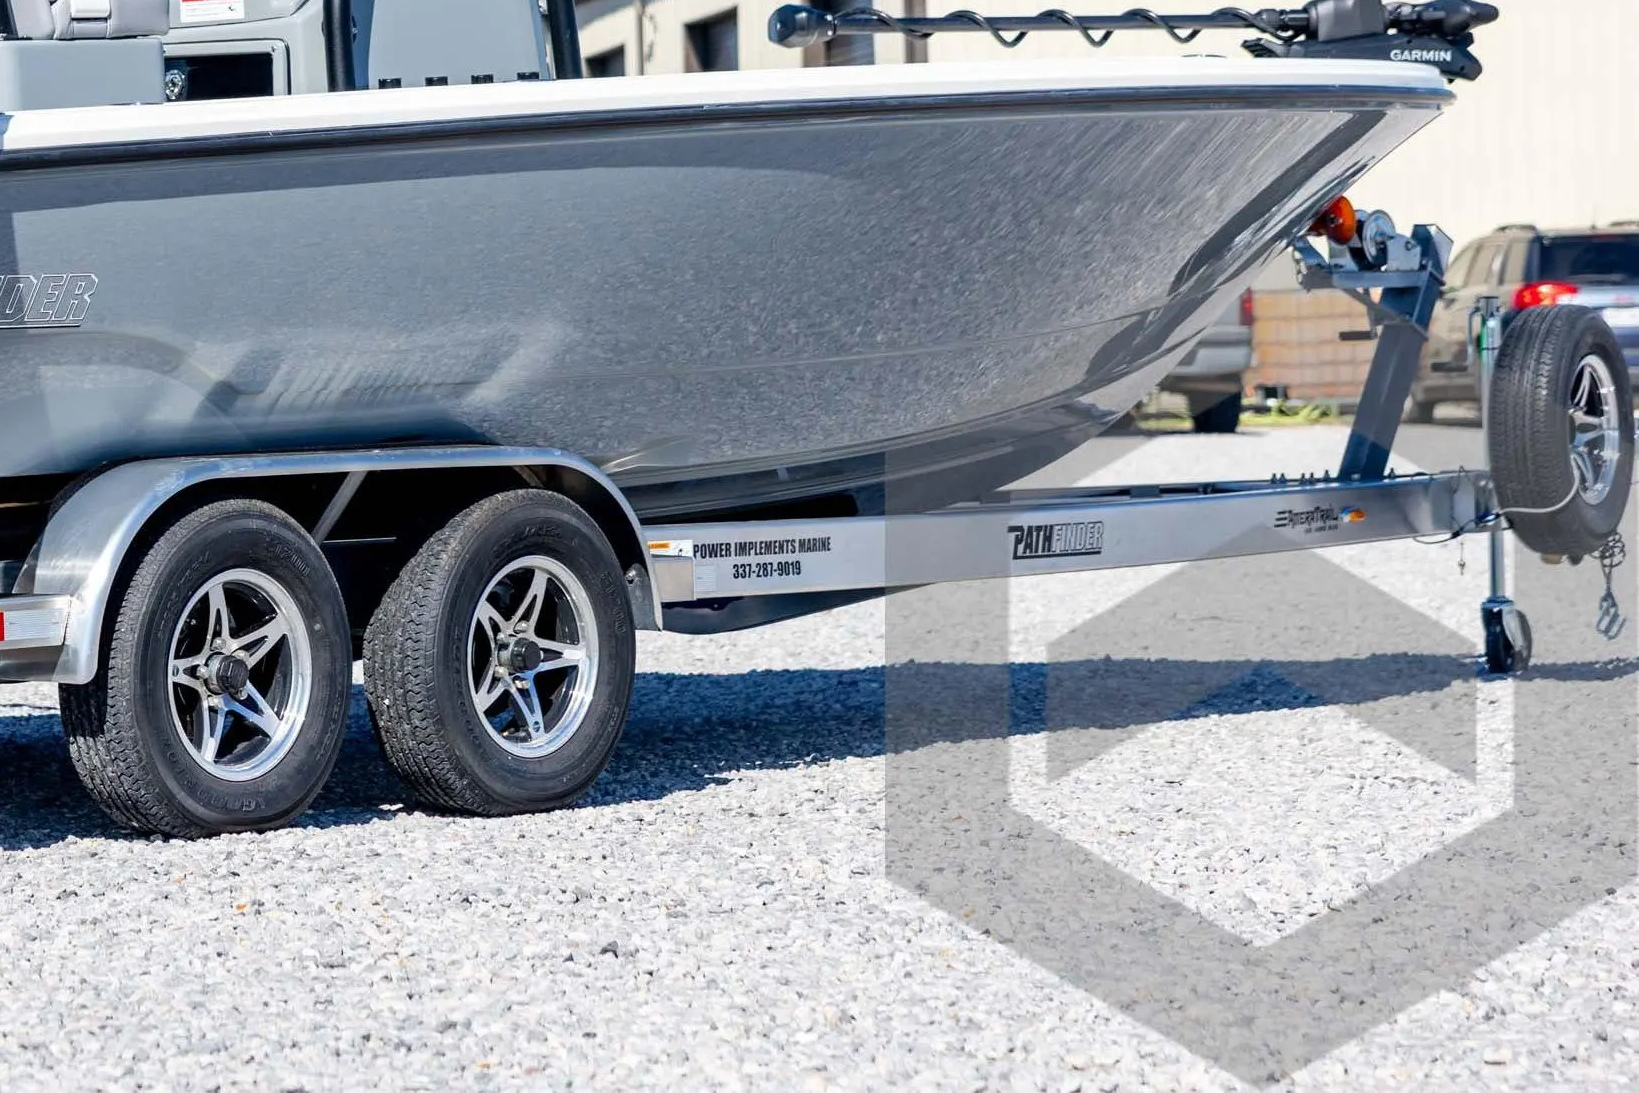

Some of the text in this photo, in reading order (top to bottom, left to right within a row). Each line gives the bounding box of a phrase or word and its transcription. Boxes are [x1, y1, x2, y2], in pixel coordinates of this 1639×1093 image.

[1390, 49, 1452, 62] GARMIN
[693, 536, 832, 559] POWER IMPLEMENTS MARINE
[1007, 521, 1104, 560] PATHFINDER
[732, 560, 802, 580] 337-287-9019
